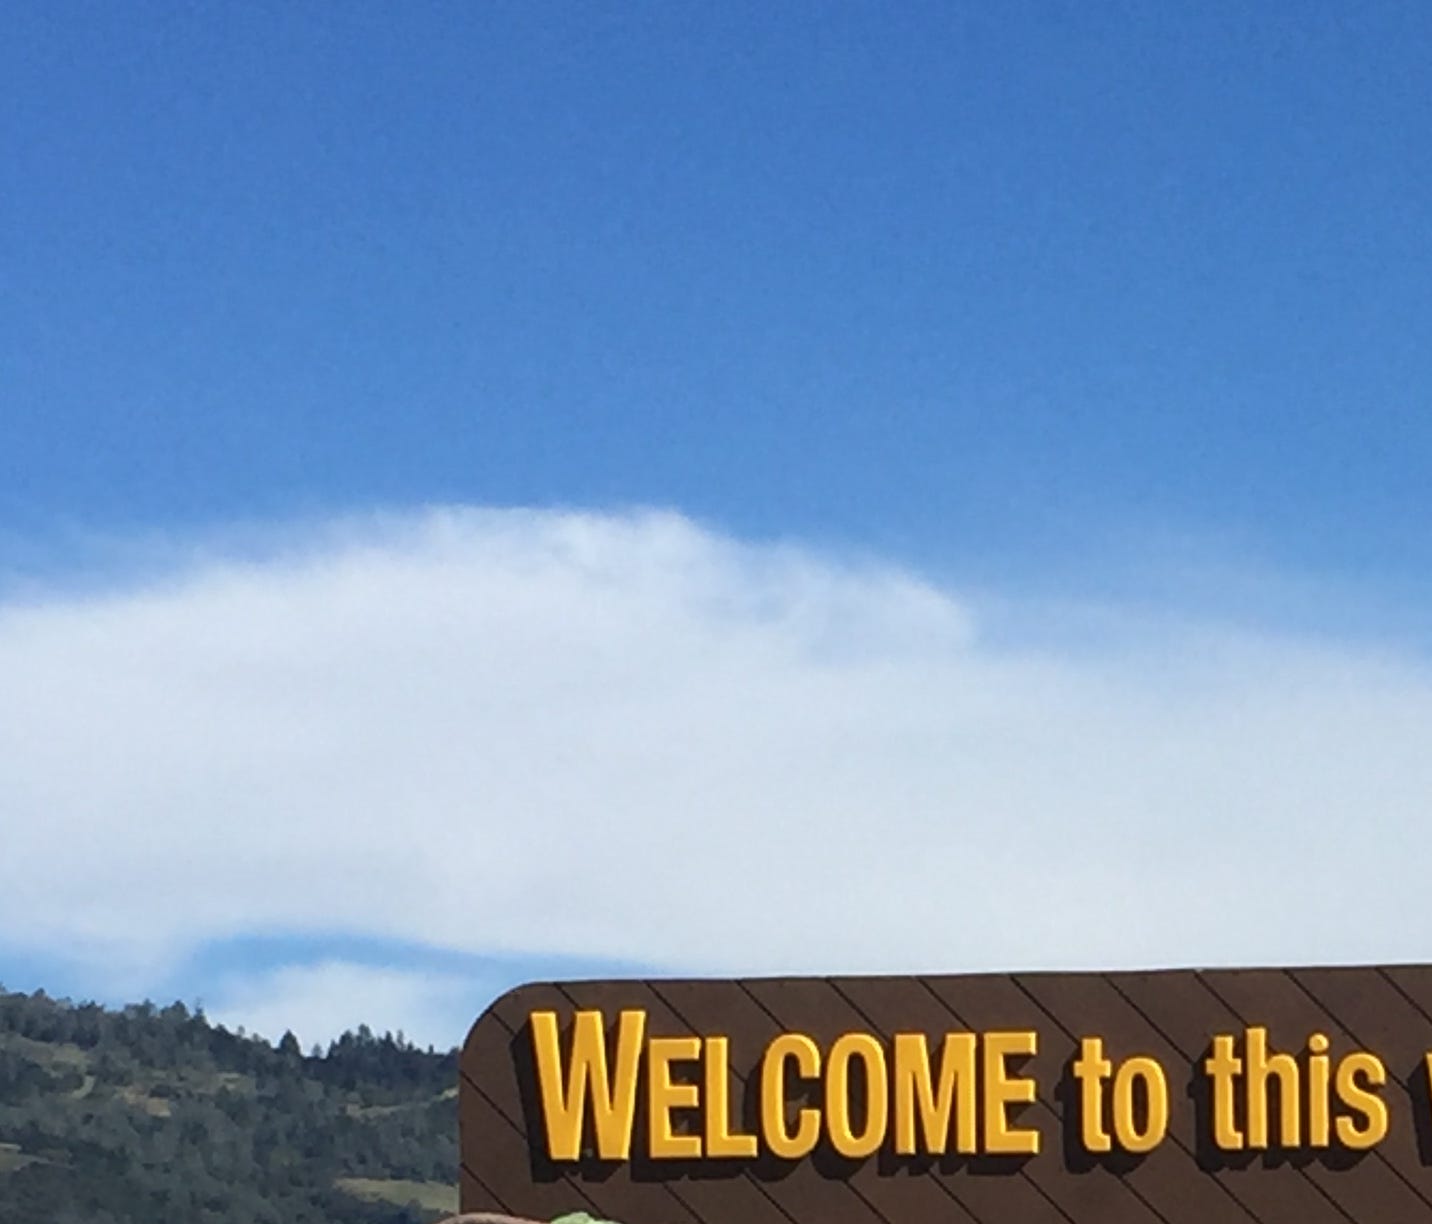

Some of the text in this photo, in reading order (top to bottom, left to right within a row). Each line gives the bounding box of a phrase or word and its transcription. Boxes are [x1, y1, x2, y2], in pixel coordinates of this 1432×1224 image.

[531, 1009, 1039, 1161] WELCOME
[1074, 1037, 1169, 1153] to
[1206, 1026, 1389, 1150] this
